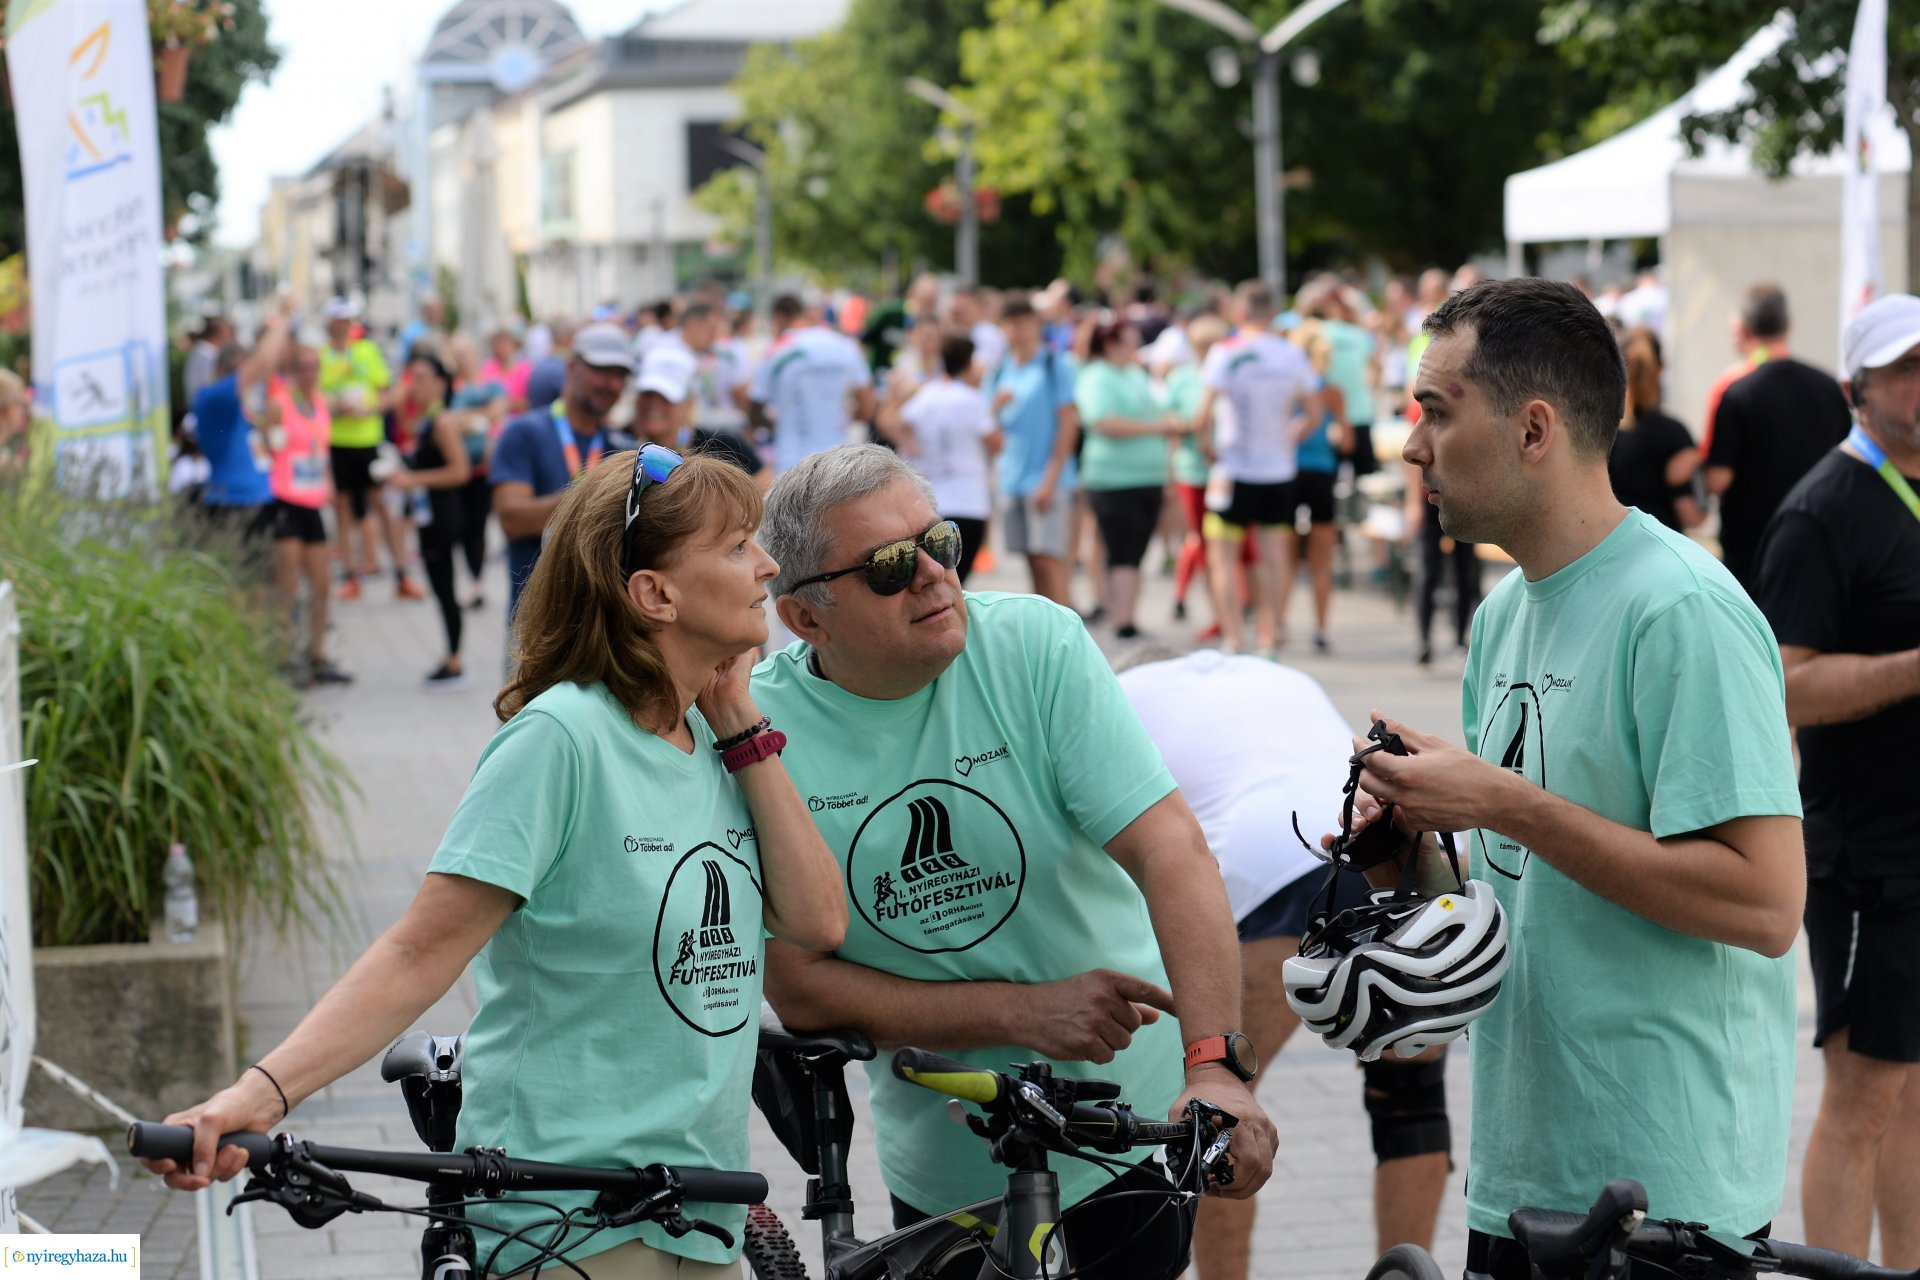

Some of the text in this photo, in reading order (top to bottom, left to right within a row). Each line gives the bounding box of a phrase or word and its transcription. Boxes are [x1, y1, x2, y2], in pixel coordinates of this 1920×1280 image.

[972, 746, 1009, 765] MOZAIK
[827, 795, 869, 810] Többet ad!
[640, 843, 662, 852] Többet
[907, 855, 959, 879] 1 2 3
[899, 867, 981, 899] I. NYÍREGYHÁZI
[876, 872, 1016, 922] FUTÓFESZTIVÁL
[923, 911, 985, 935] támogatásával
[712, 931, 719, 943] 2
[724, 929, 731, 941] 3
[669, 955, 757, 985] FUTÓFESZTIVÁ
